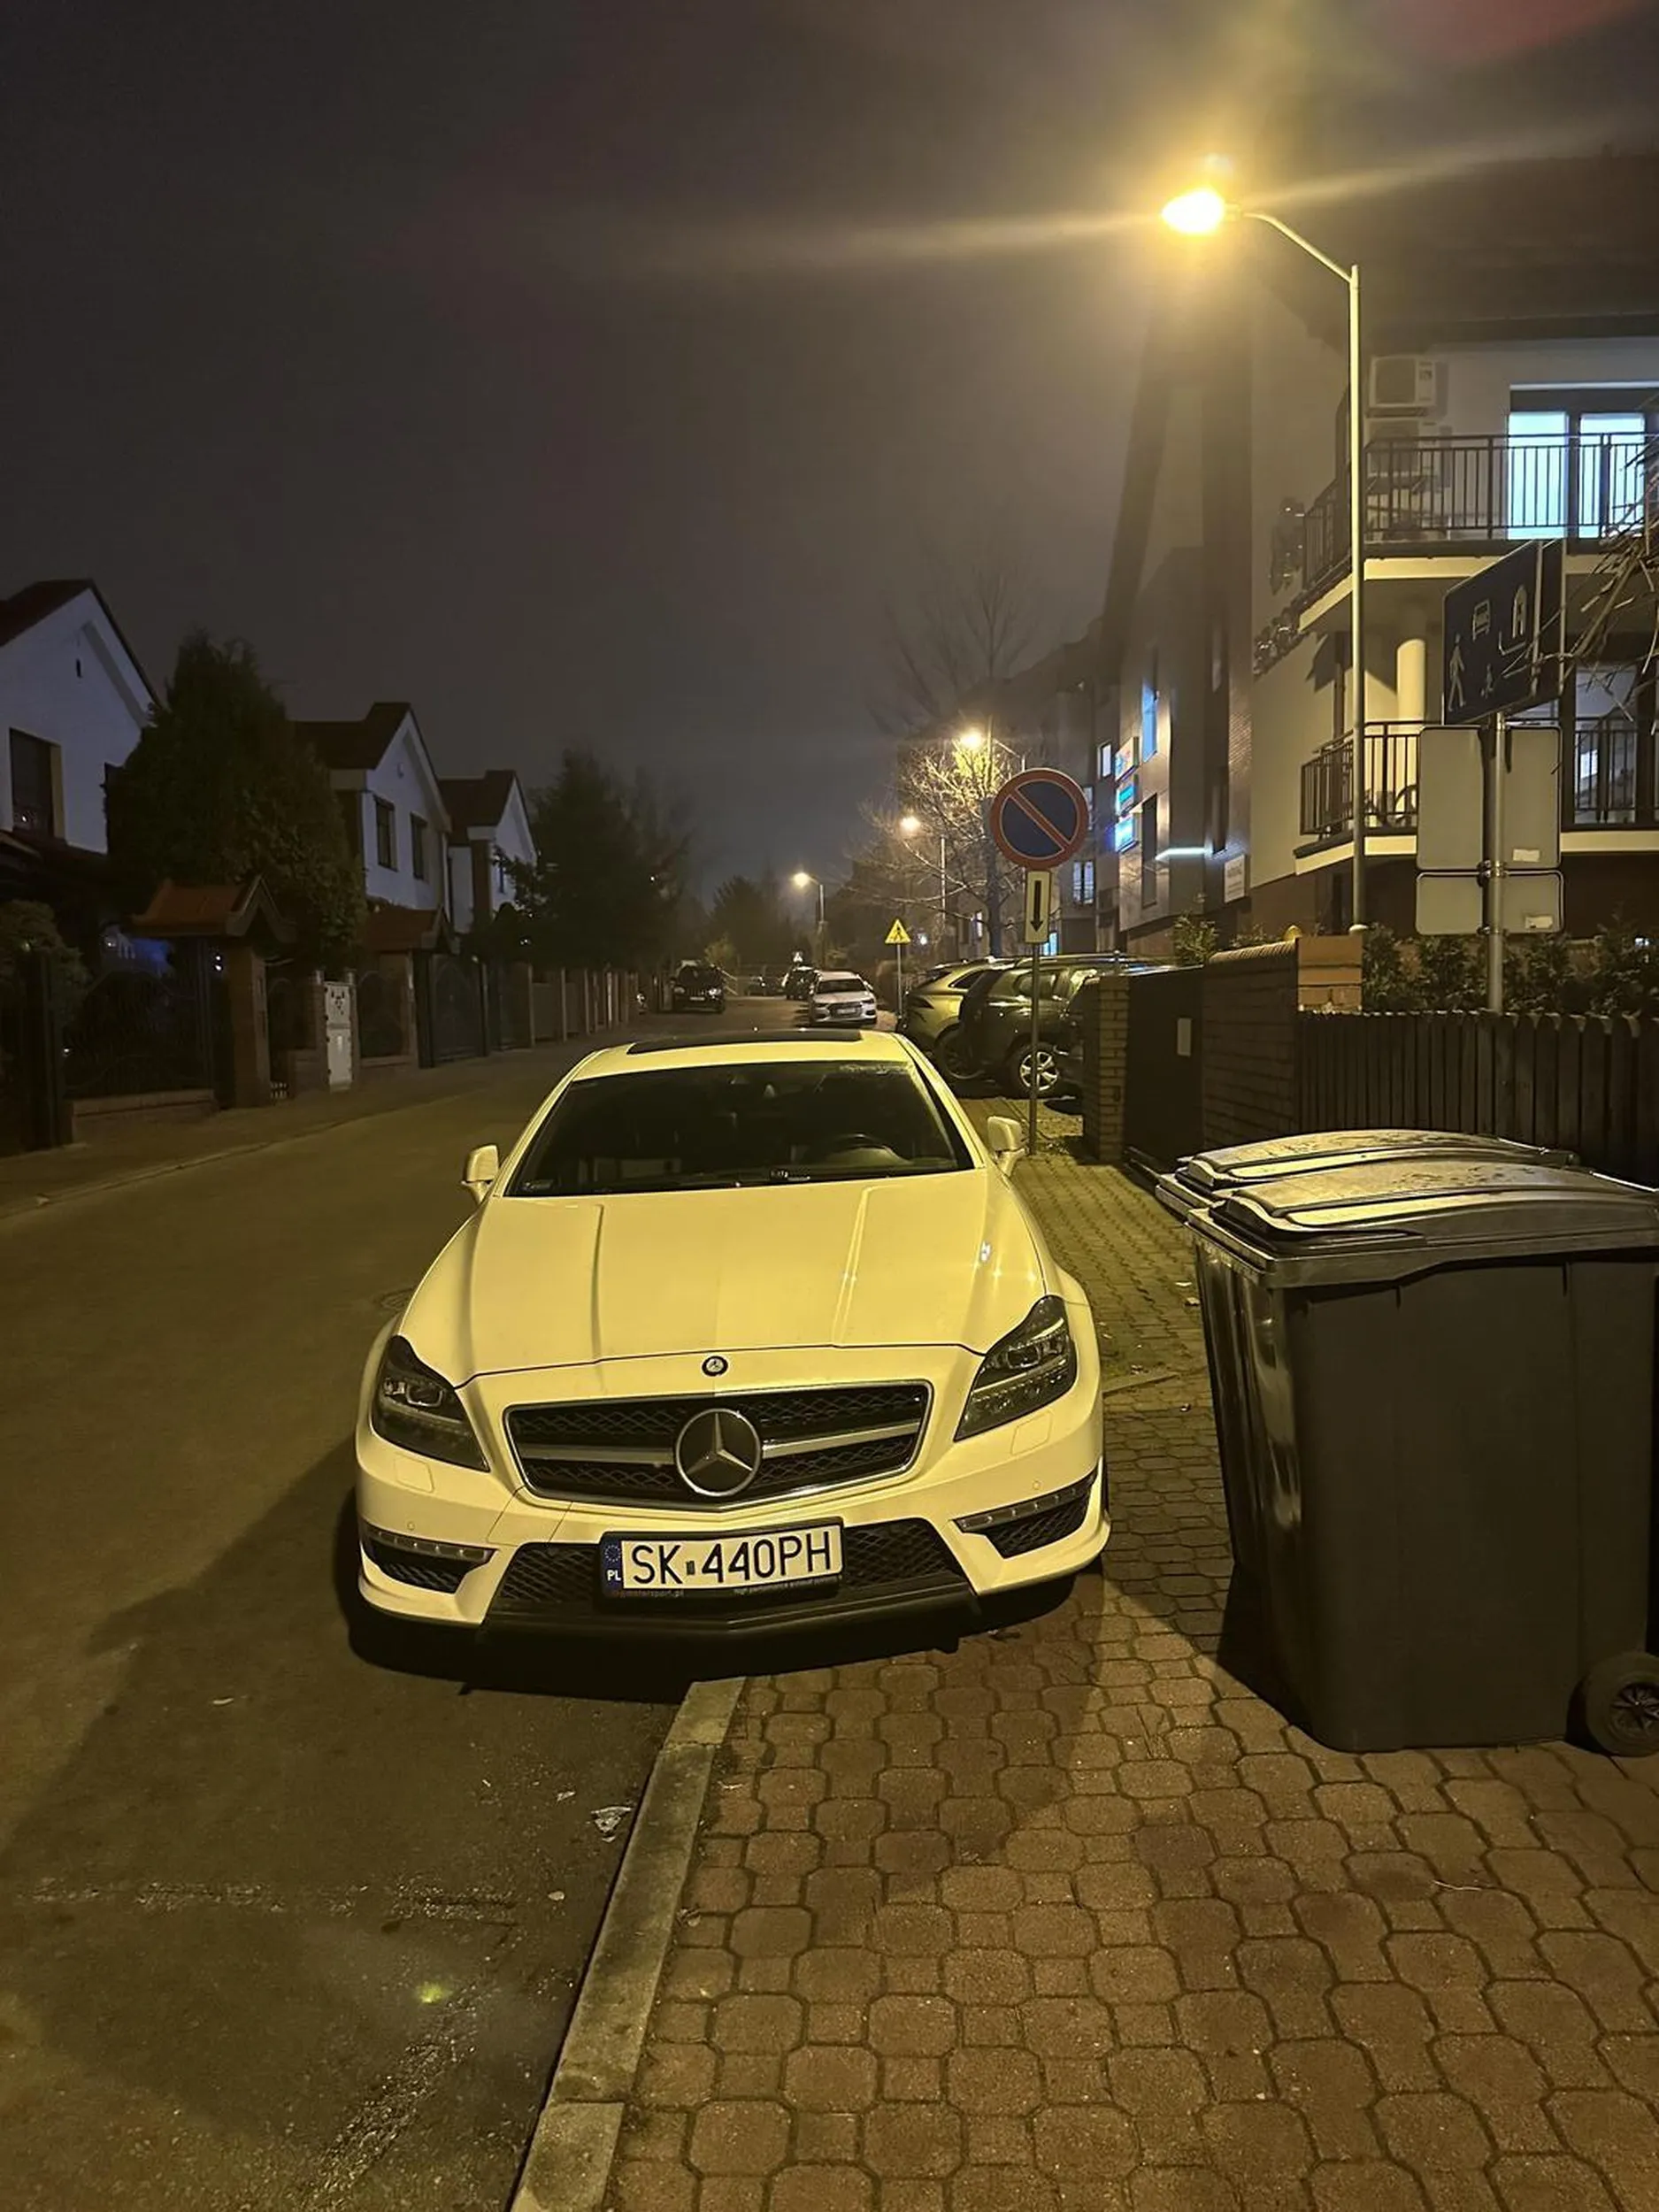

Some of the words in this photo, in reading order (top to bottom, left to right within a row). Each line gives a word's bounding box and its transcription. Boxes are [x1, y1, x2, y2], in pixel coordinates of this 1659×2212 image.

[631, 1544, 683, 1585] SK
[701, 1531, 831, 1583] 440PH
[607, 1570, 621, 1581] PL
